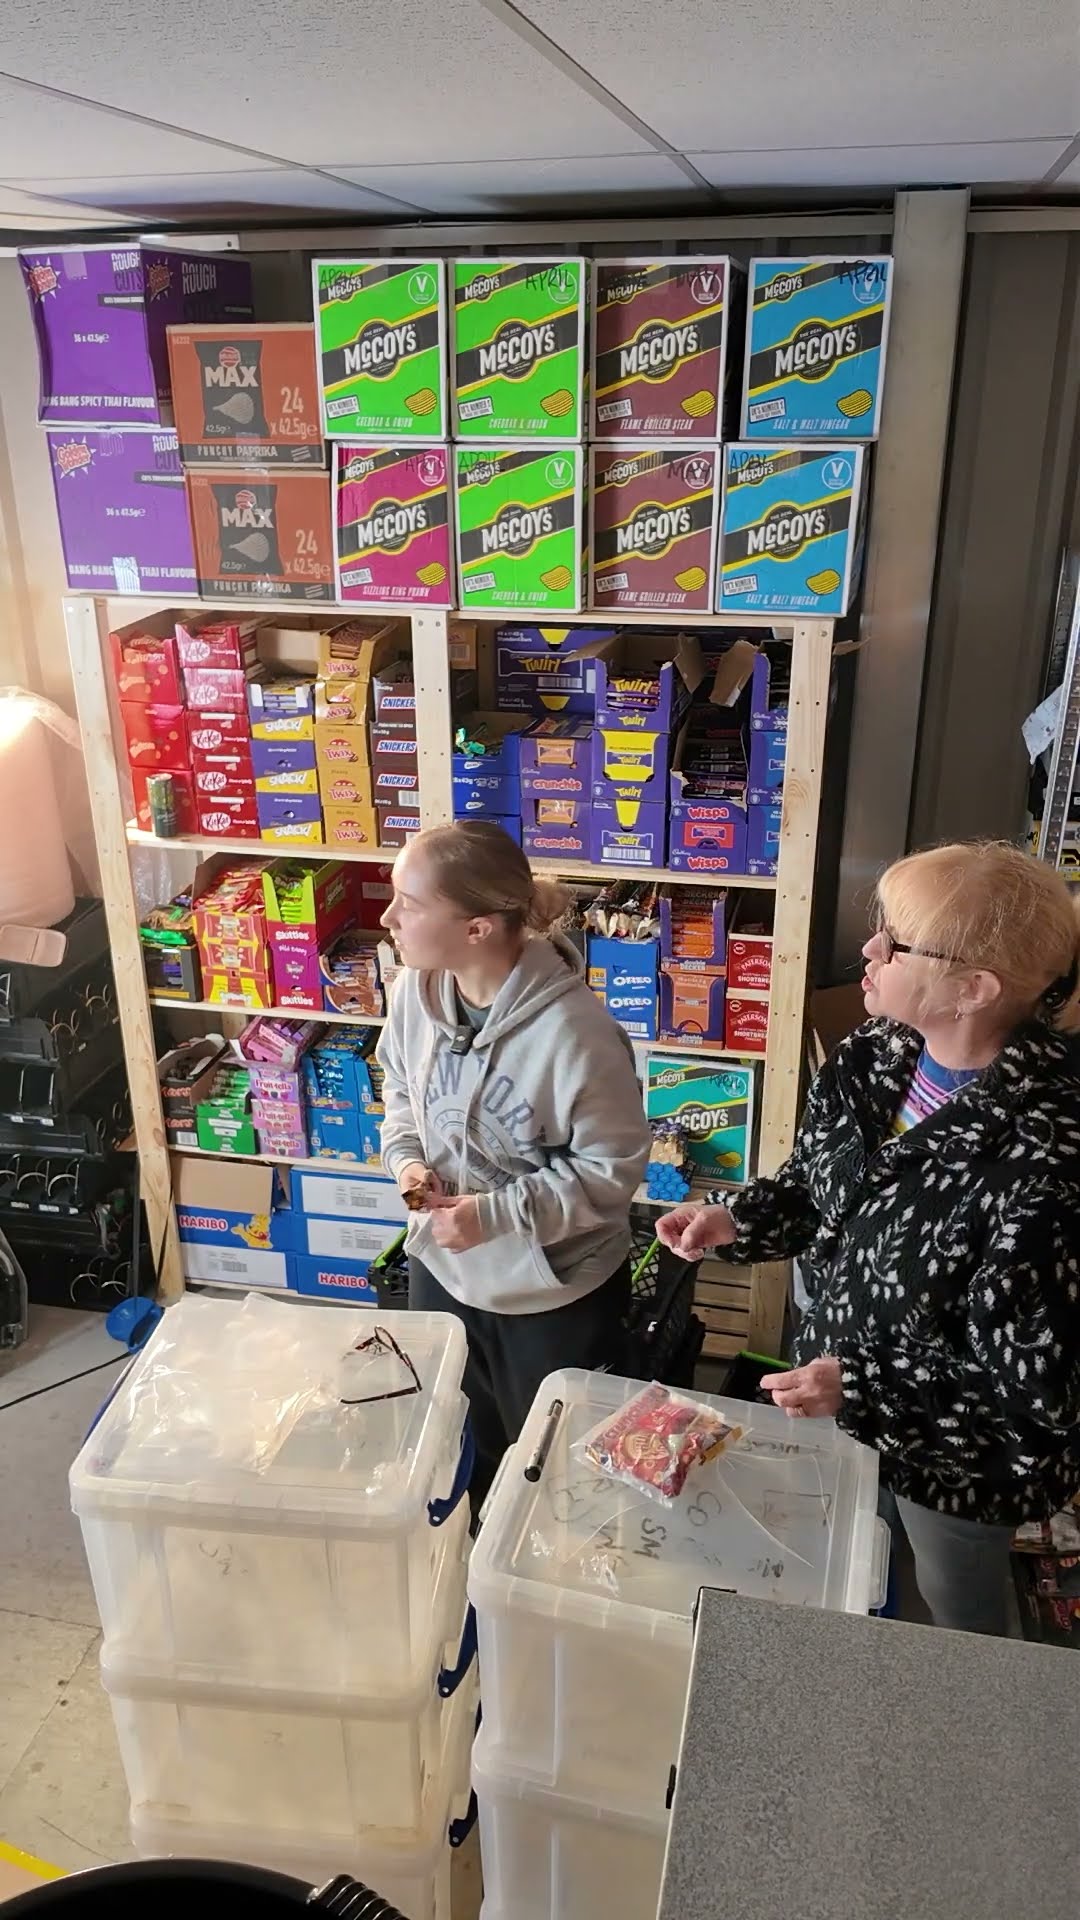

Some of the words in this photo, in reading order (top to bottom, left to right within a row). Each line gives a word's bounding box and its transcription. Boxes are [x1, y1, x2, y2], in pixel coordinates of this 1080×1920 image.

[204, 366, 259, 388] MAX
[80, 396, 102, 407] SPICY
[104, 396, 122, 407] THAI
[123, 397, 156, 408] FLAVOUR
[281, 387, 304, 414] 24
[152, 435, 179, 452] ROUG
[197, 446, 233, 457] PUNCHY
[236, 446, 278, 457] PAPRIKA
[155, 452, 182, 470] CUT
[221, 507, 274, 528] MAX
[295, 529, 318, 555] 24
[69, 565, 91, 575] BANG
[140, 566, 160, 577] THAI
[213, 581, 248, 592] PUNCHY
[383, 698, 416, 708] SNICKER
[379, 742, 416, 752] SNICKERS
[379, 775, 415, 786] SNICKERS
[533, 778, 582, 791] crunchie
[688, 807, 729, 820] Wispa
[386, 818, 421, 828] SNICKERS
[534, 837, 582, 849] crunchie
[687, 857, 728, 869] Wispa
[613, 976, 652, 987] OREO
[609, 997, 652, 1008] OREO
[180, 1216, 227, 1230] HARIBO
[319, 1273, 367, 1288] HARIBO
